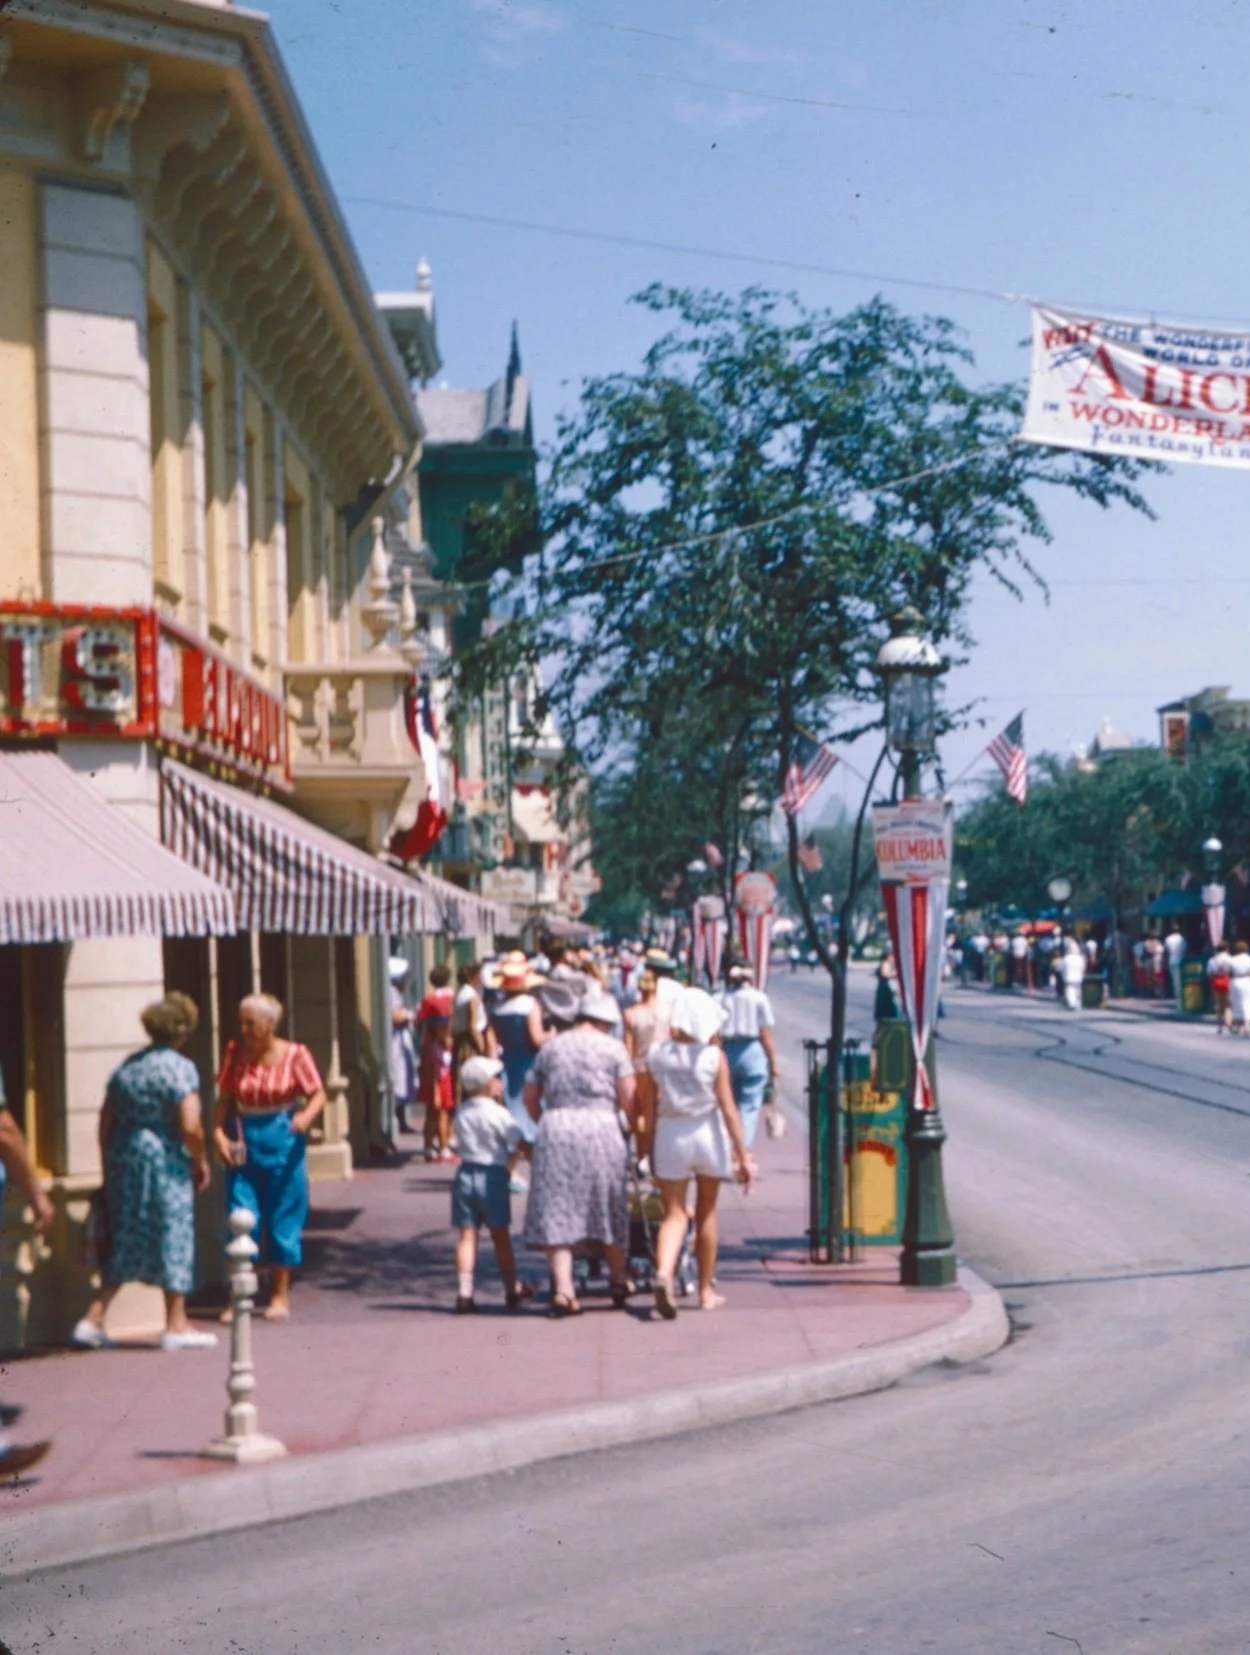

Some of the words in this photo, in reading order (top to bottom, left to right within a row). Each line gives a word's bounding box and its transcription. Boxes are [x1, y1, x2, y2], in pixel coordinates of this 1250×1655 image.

[1101, 325, 1140, 343] THE
[1143, 348, 1219, 367] WORLD
[1043, 402, 1060, 412] IN
[876, 838, 947, 862] COLUMBIA
